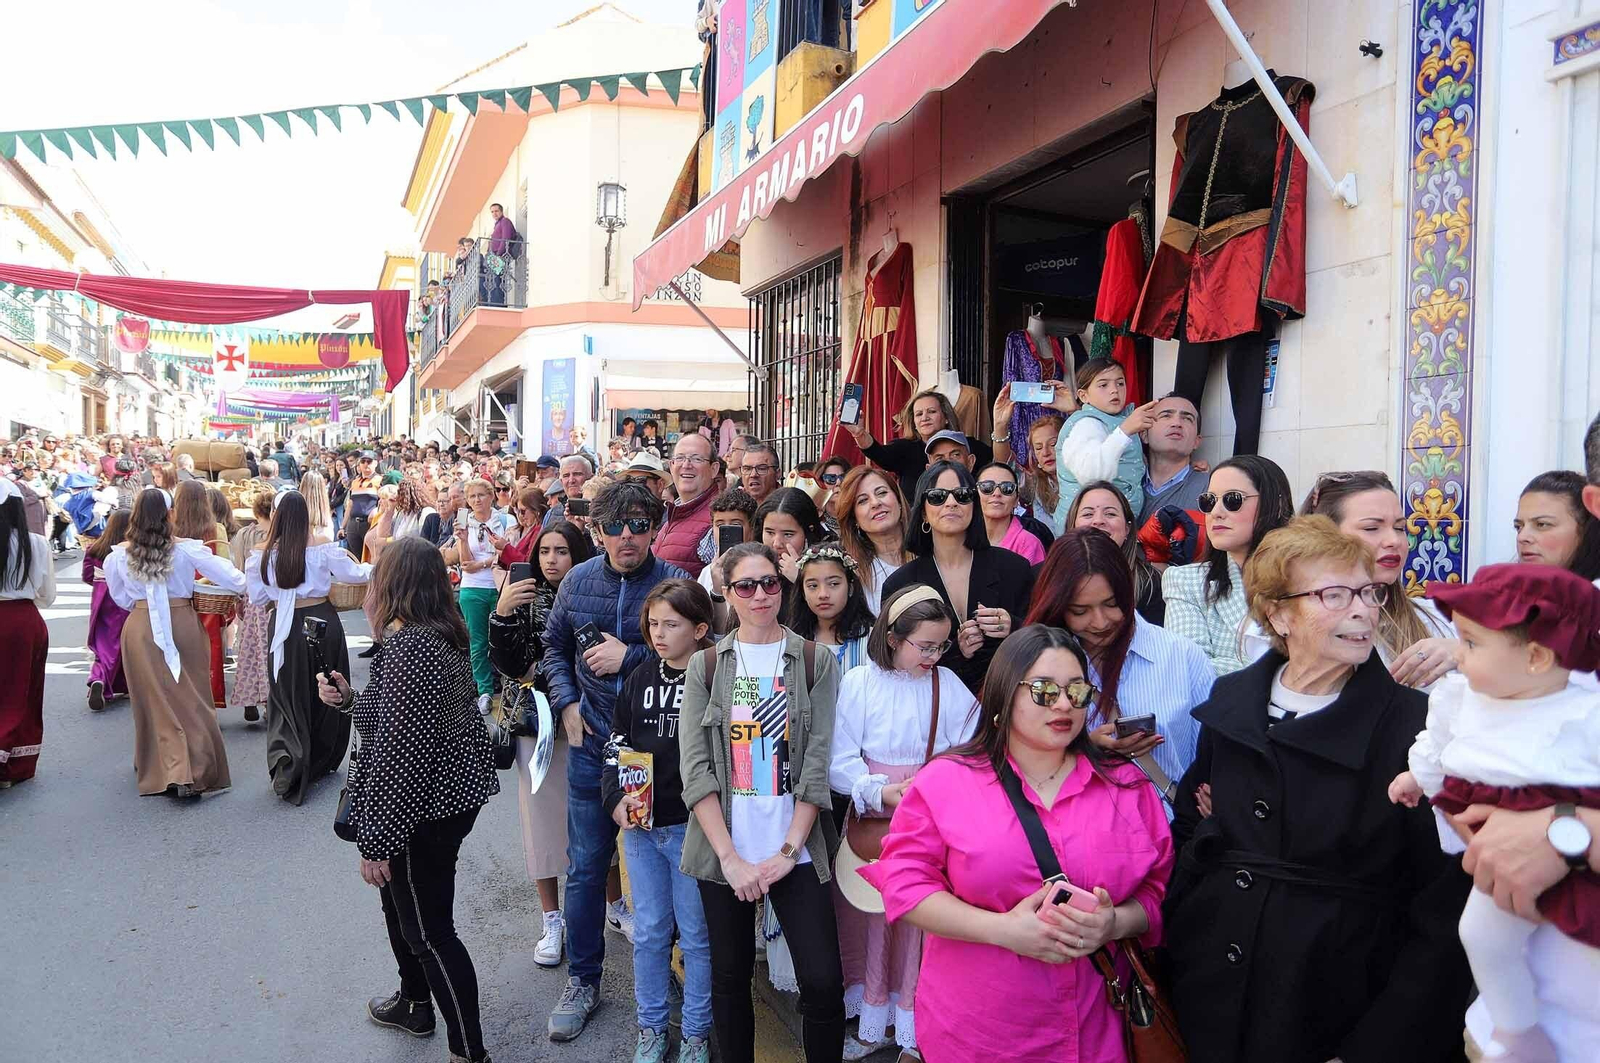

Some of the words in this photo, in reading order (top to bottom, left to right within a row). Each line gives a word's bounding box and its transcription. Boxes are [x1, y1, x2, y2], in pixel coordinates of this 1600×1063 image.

[704, 203, 727, 252] MI
[736, 93, 864, 229] ARMARIO
[730, 724, 756, 740] ST
